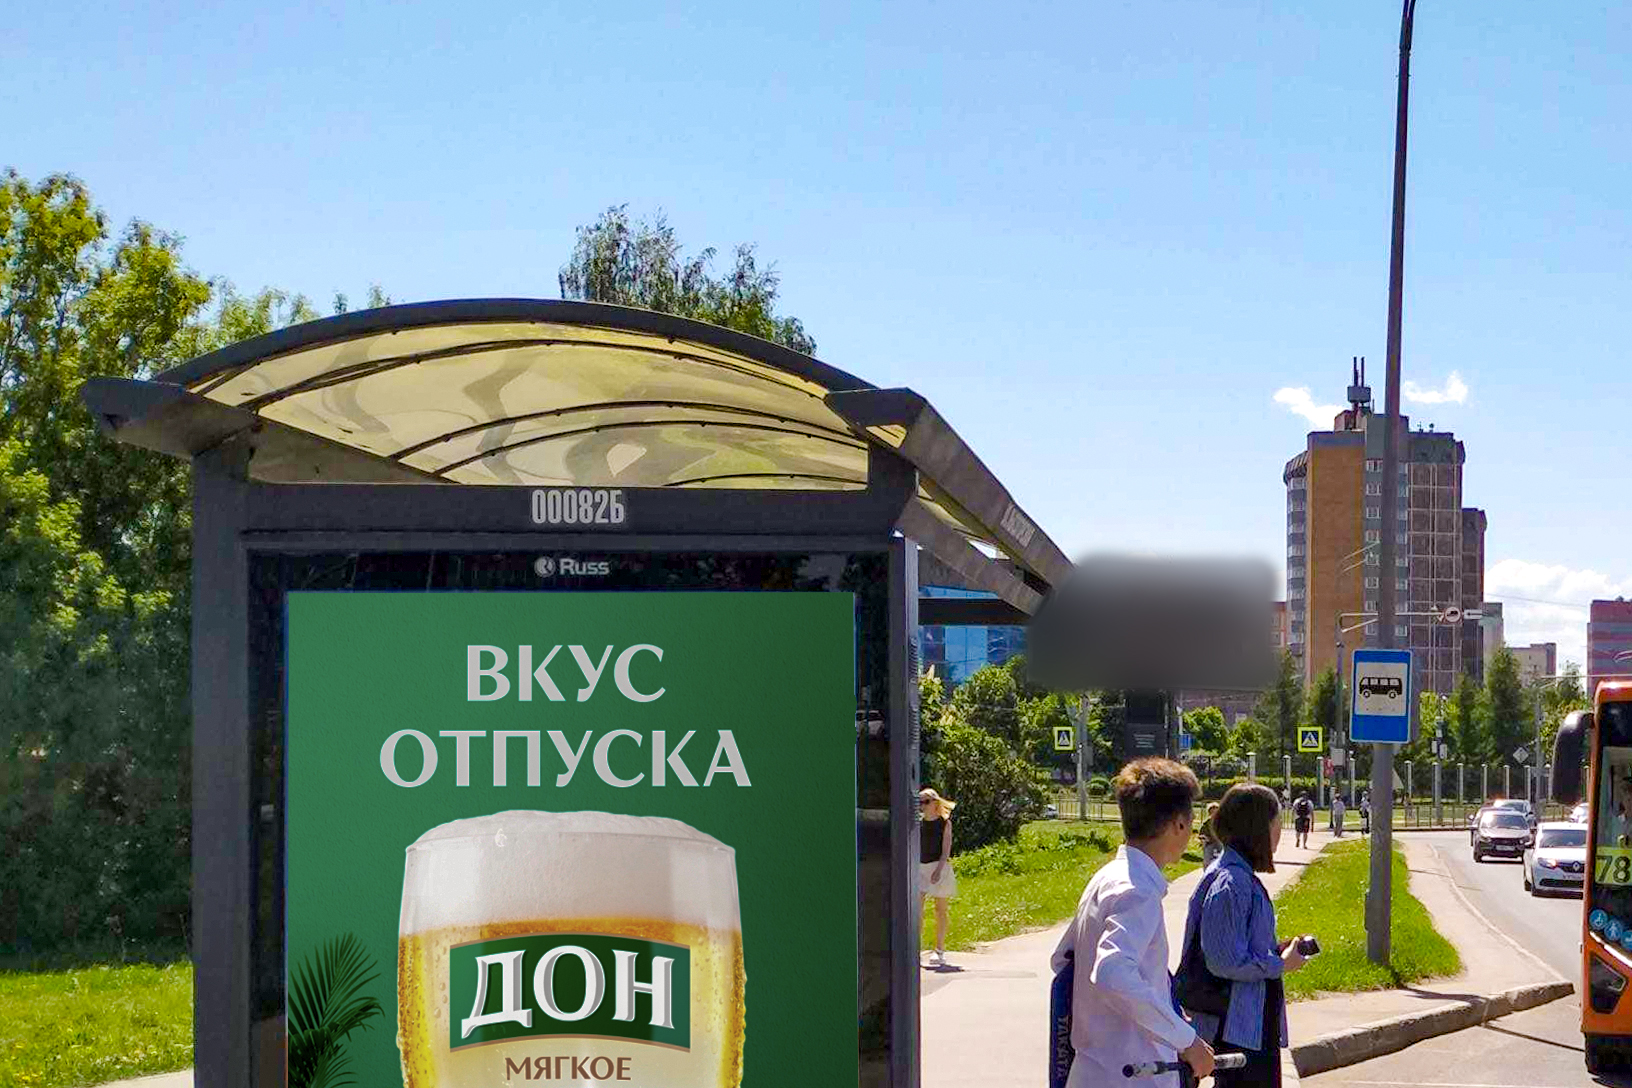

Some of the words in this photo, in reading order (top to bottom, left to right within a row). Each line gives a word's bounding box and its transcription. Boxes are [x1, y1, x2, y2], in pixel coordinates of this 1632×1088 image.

[559, 558, 610, 576] Russ
[466, 643, 667, 703] ВКУС
[379, 728, 752, 788] ОТПУСКА
[1596, 855, 1631, 883] 78
[461, 944, 677, 1039] ДОН
[505, 1055, 632, 1082] МЯГКОЕ
